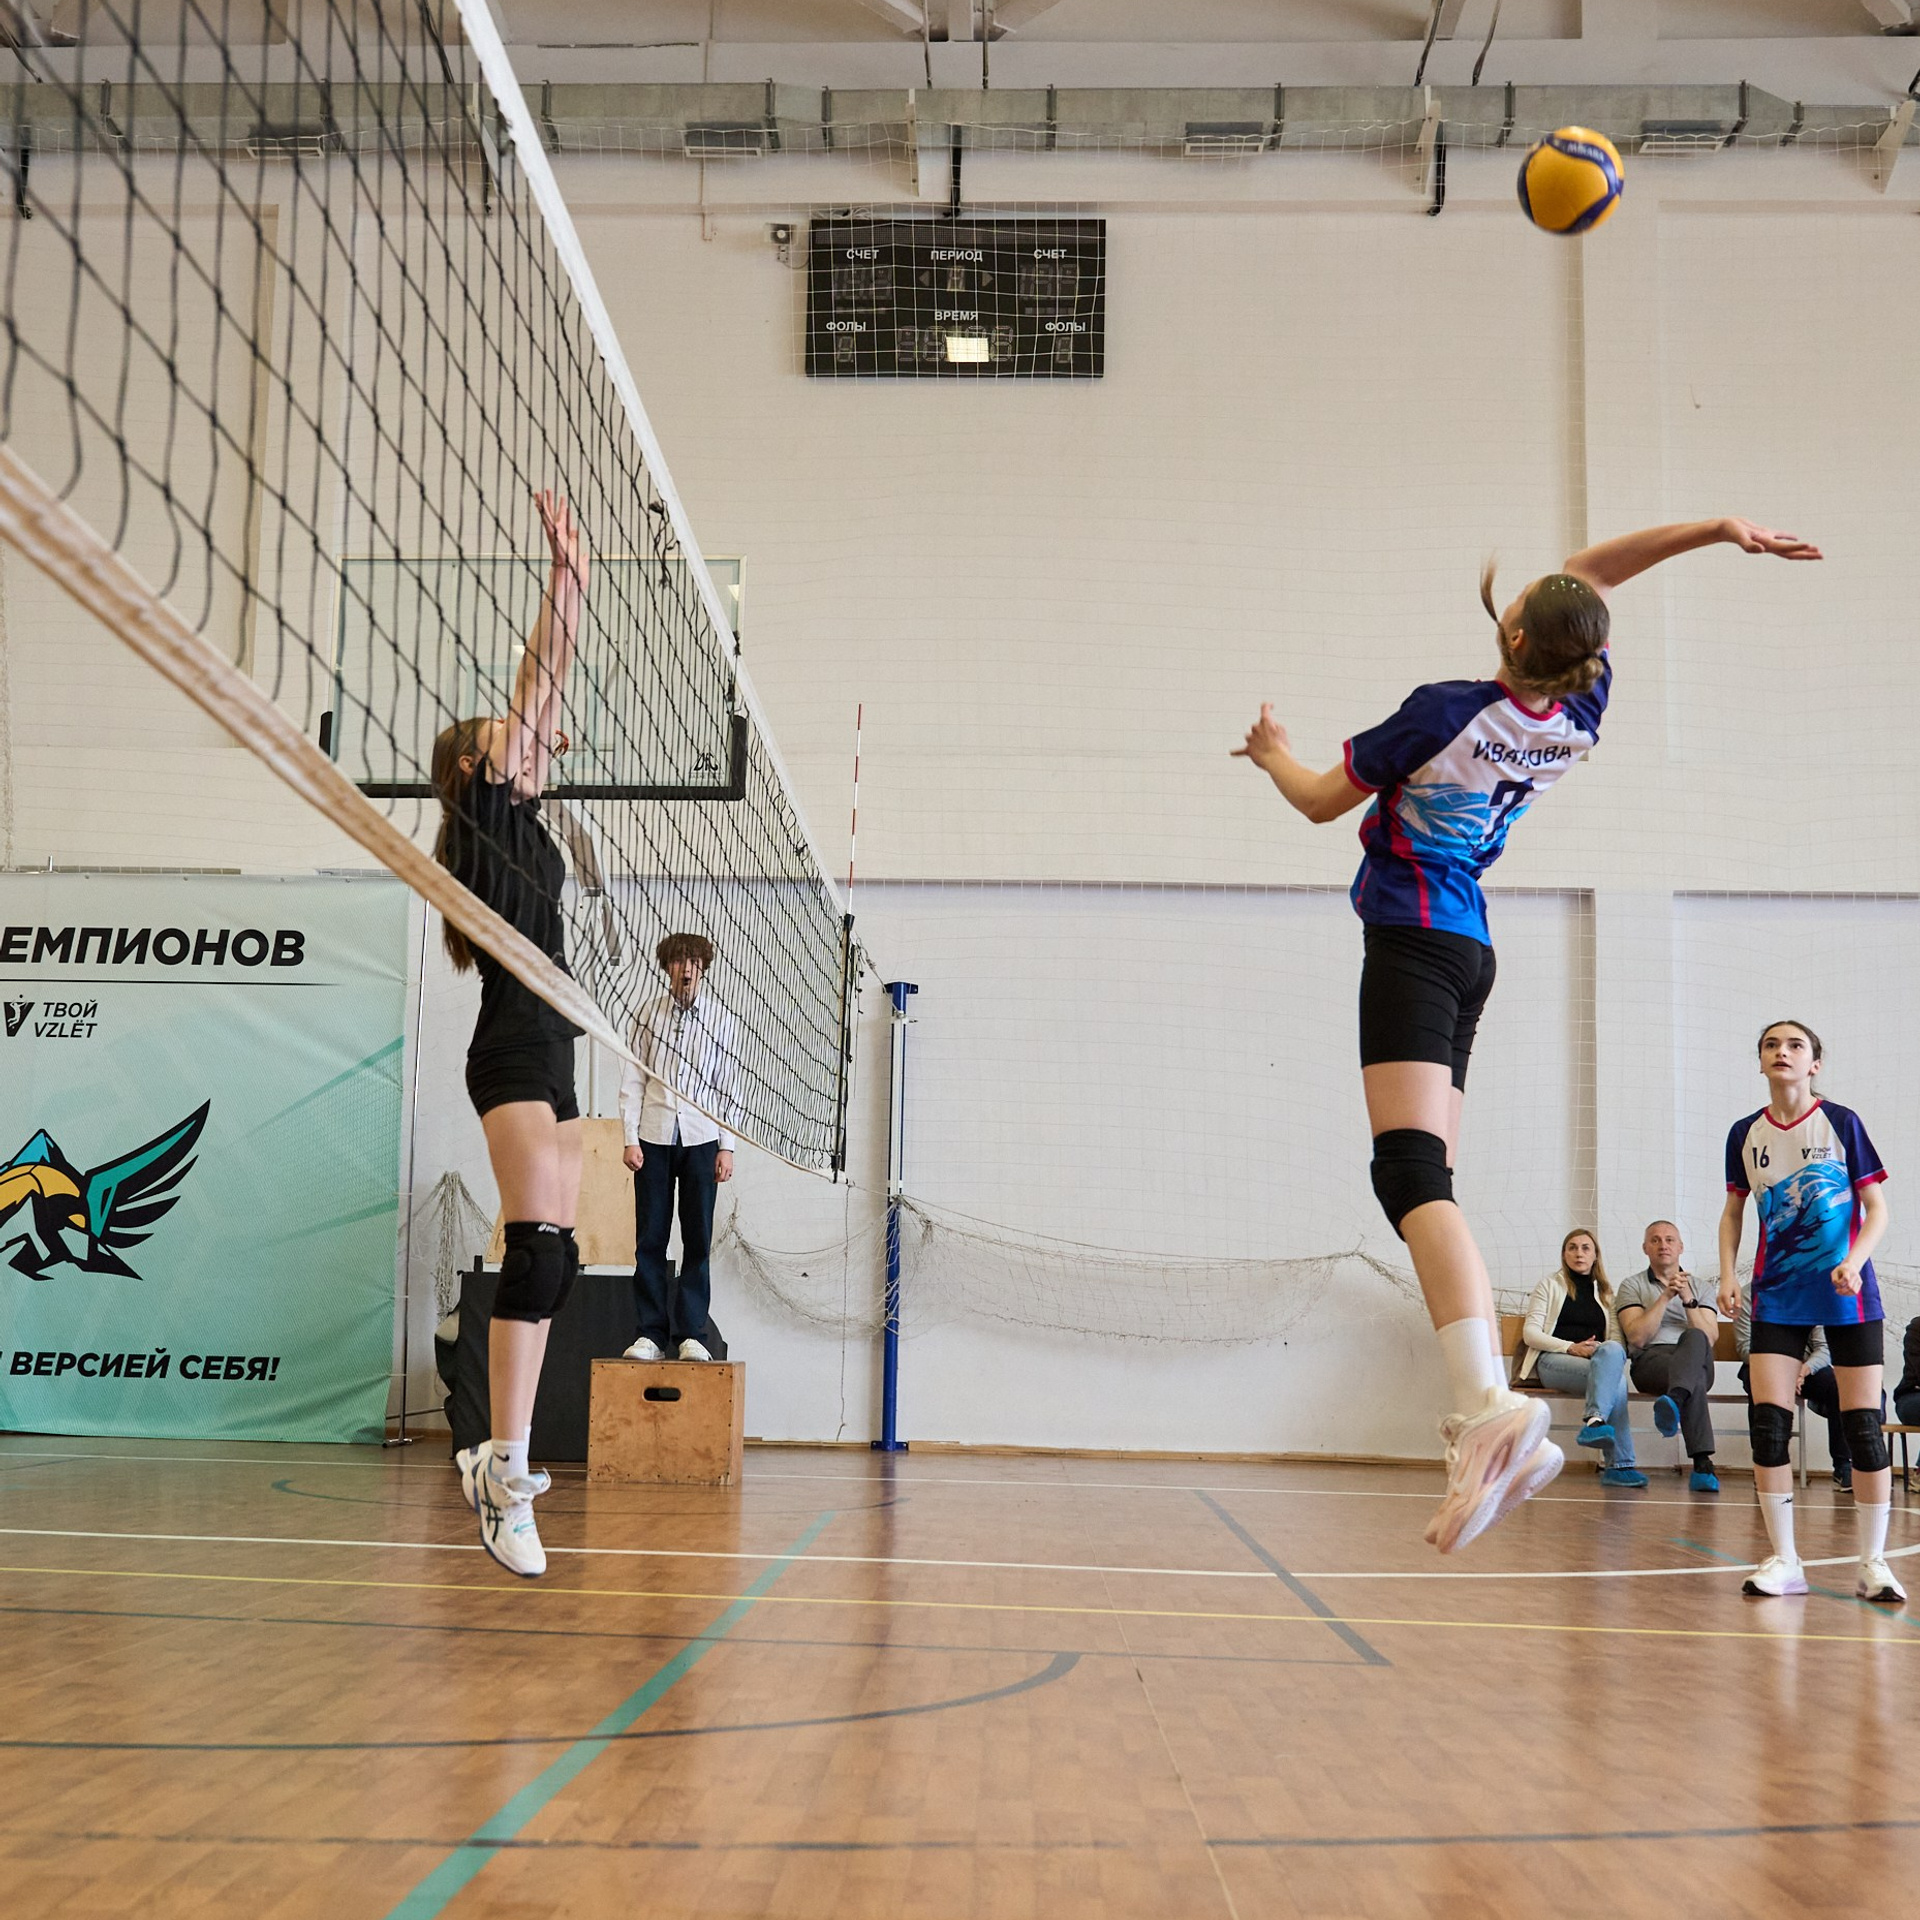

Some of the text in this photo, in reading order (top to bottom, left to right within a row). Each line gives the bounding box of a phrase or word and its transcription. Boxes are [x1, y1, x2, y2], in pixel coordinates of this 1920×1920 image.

[846, 249, 879, 260] СЧЕТ
[930, 250, 983, 262] ПЕРИОД
[1033, 249, 1067, 260] СЧЕТ
[934, 310, 979, 321] ВРЕМЯ
[826, 321, 866, 332] ФОЛЫ
[1045, 321, 1086, 332] ФОЛЫ
[1484, 777, 1535, 843] 7
[0, 926, 306, 967] ЕМПИОНОВ
[43, 999, 98, 1018] ТВОЙ
[1752, 1146, 1770, 1169] 16
[10, 1347, 280, 1381] ВЕРСИЕЙ СЕБЯ!
